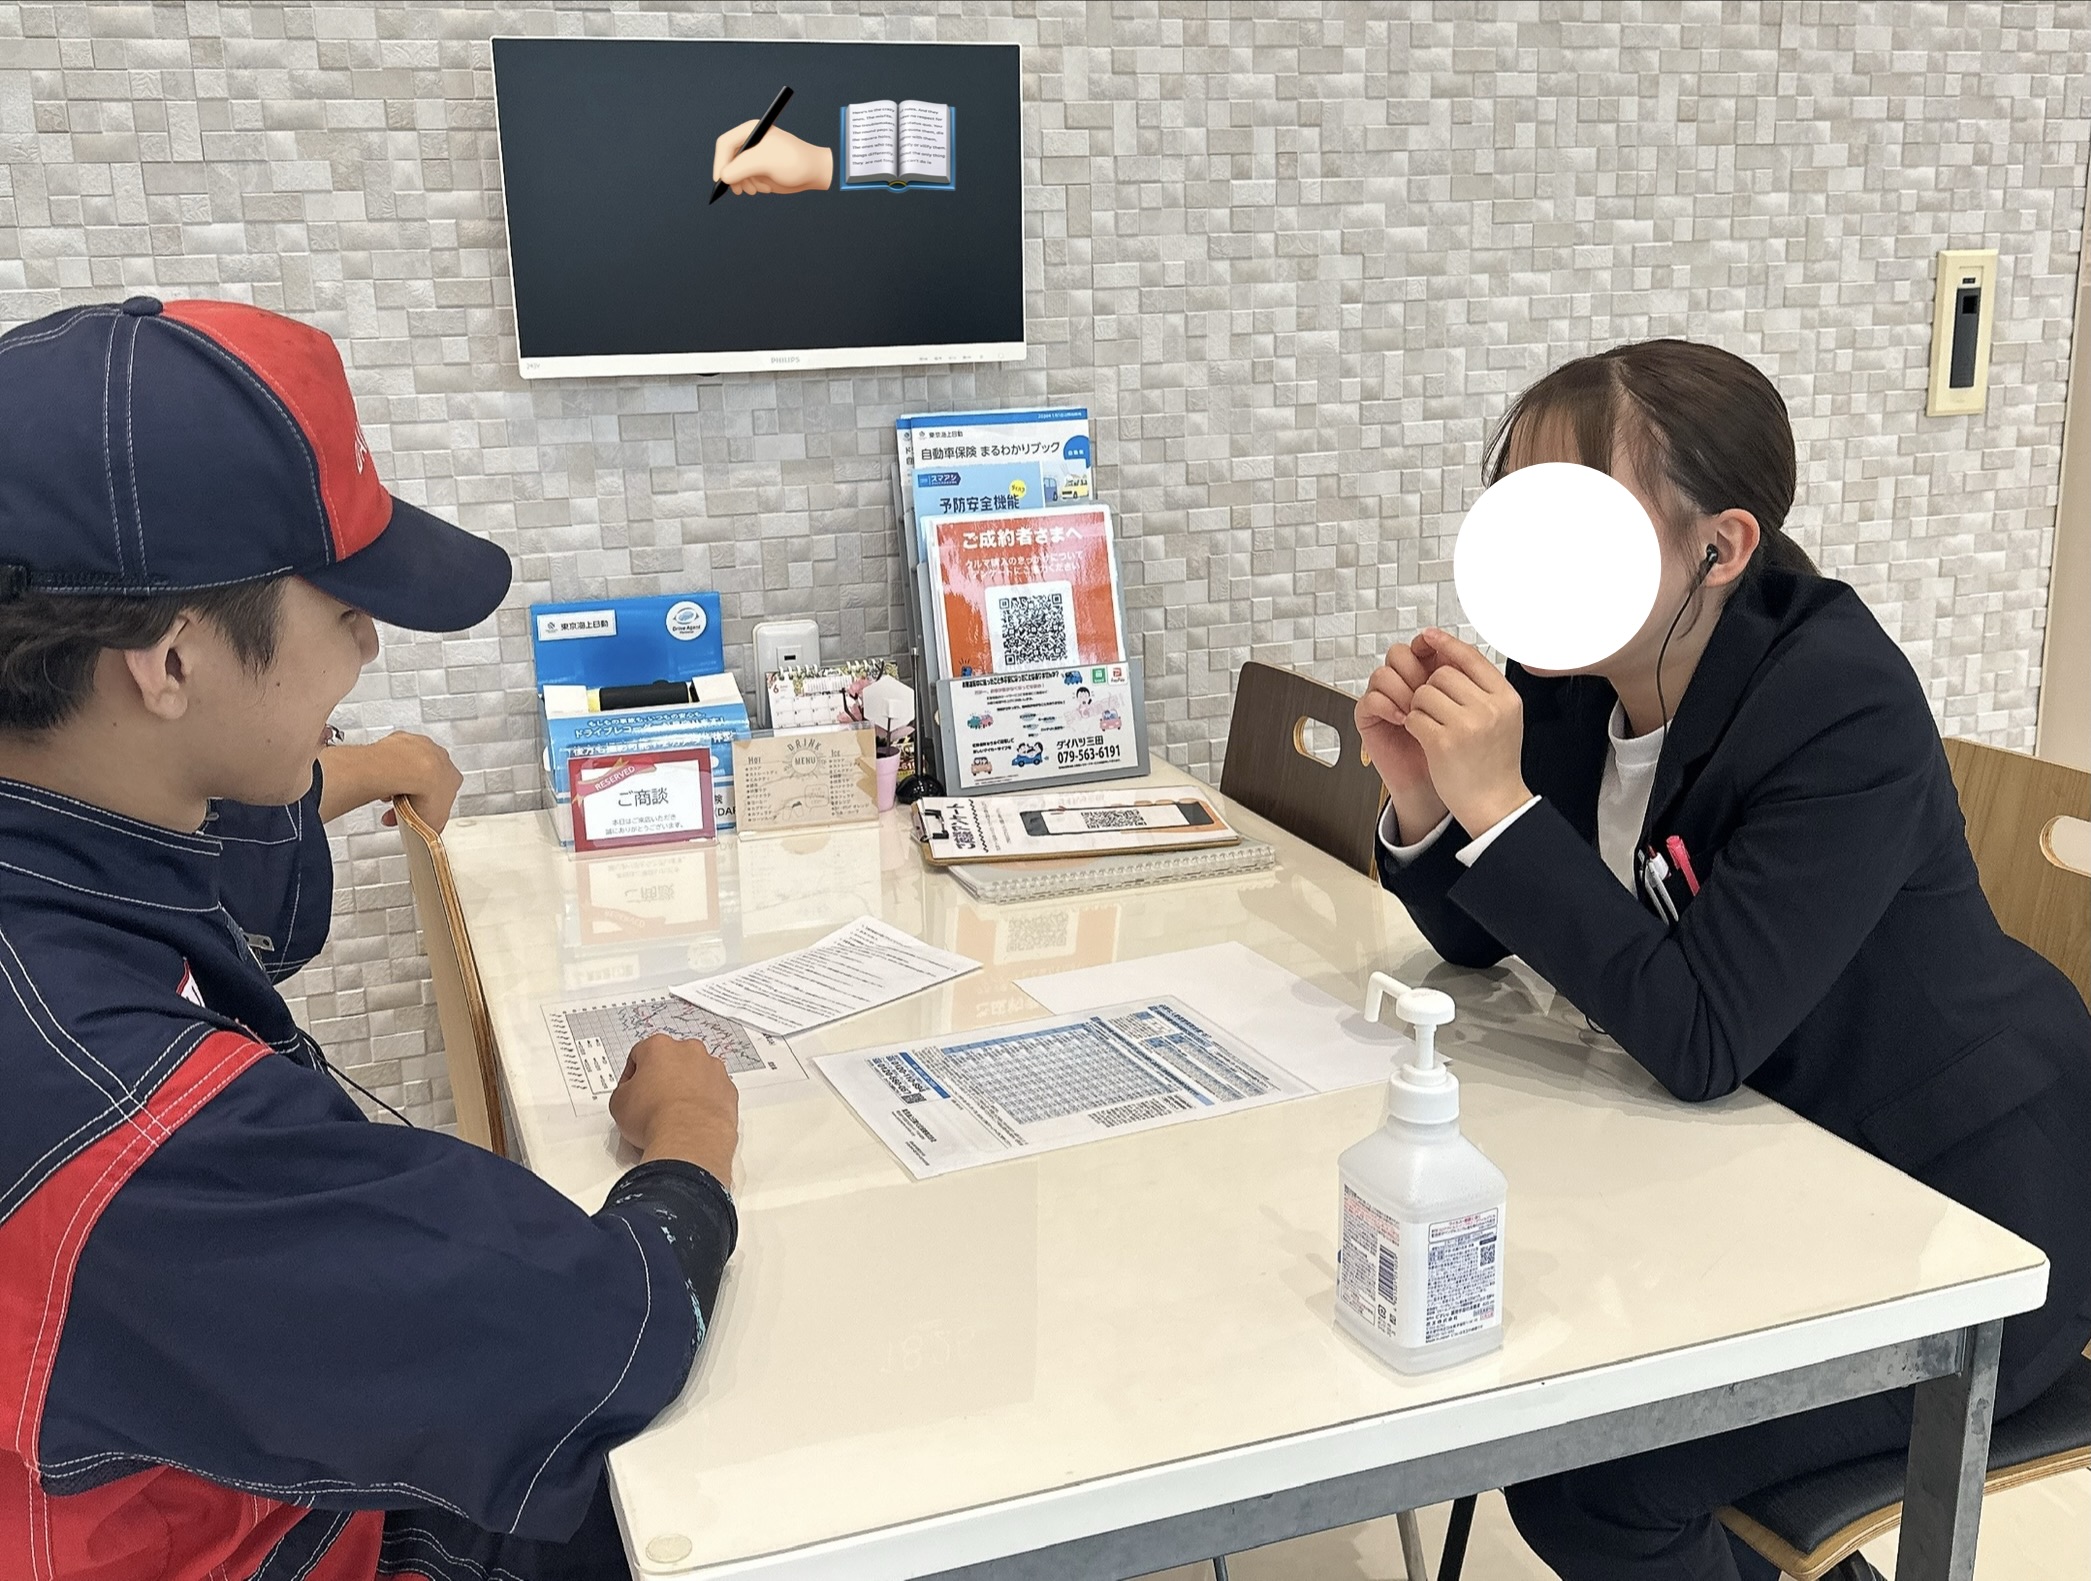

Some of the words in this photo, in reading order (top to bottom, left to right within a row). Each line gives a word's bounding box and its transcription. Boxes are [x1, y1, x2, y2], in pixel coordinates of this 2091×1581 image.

[770, 356, 800, 364] PHILIPS
[921, 446, 978, 460] 自動車保険
[980, 442, 1060, 457] まるわかりブック
[939, 494, 1020, 514] 予防安全機能
[962, 527, 1082, 550] ご成約者さまへ
[560, 620, 608, 630] 東京海上日動
[773, 685, 779, 694] 6
[788, 738, 822, 752] DRINK
[1056, 735, 1104, 750] ダイハツ三田
[794, 756, 816, 766] MENU
[1058, 745, 1121, 764] 079-563-6191
[594, 765, 636, 790] RESERVED
[618, 788, 669, 808] ご商談
[612, 814, 676, 826] 本日はご来店いただき
[605, 822, 684, 836] 誠にありがとうございます。
